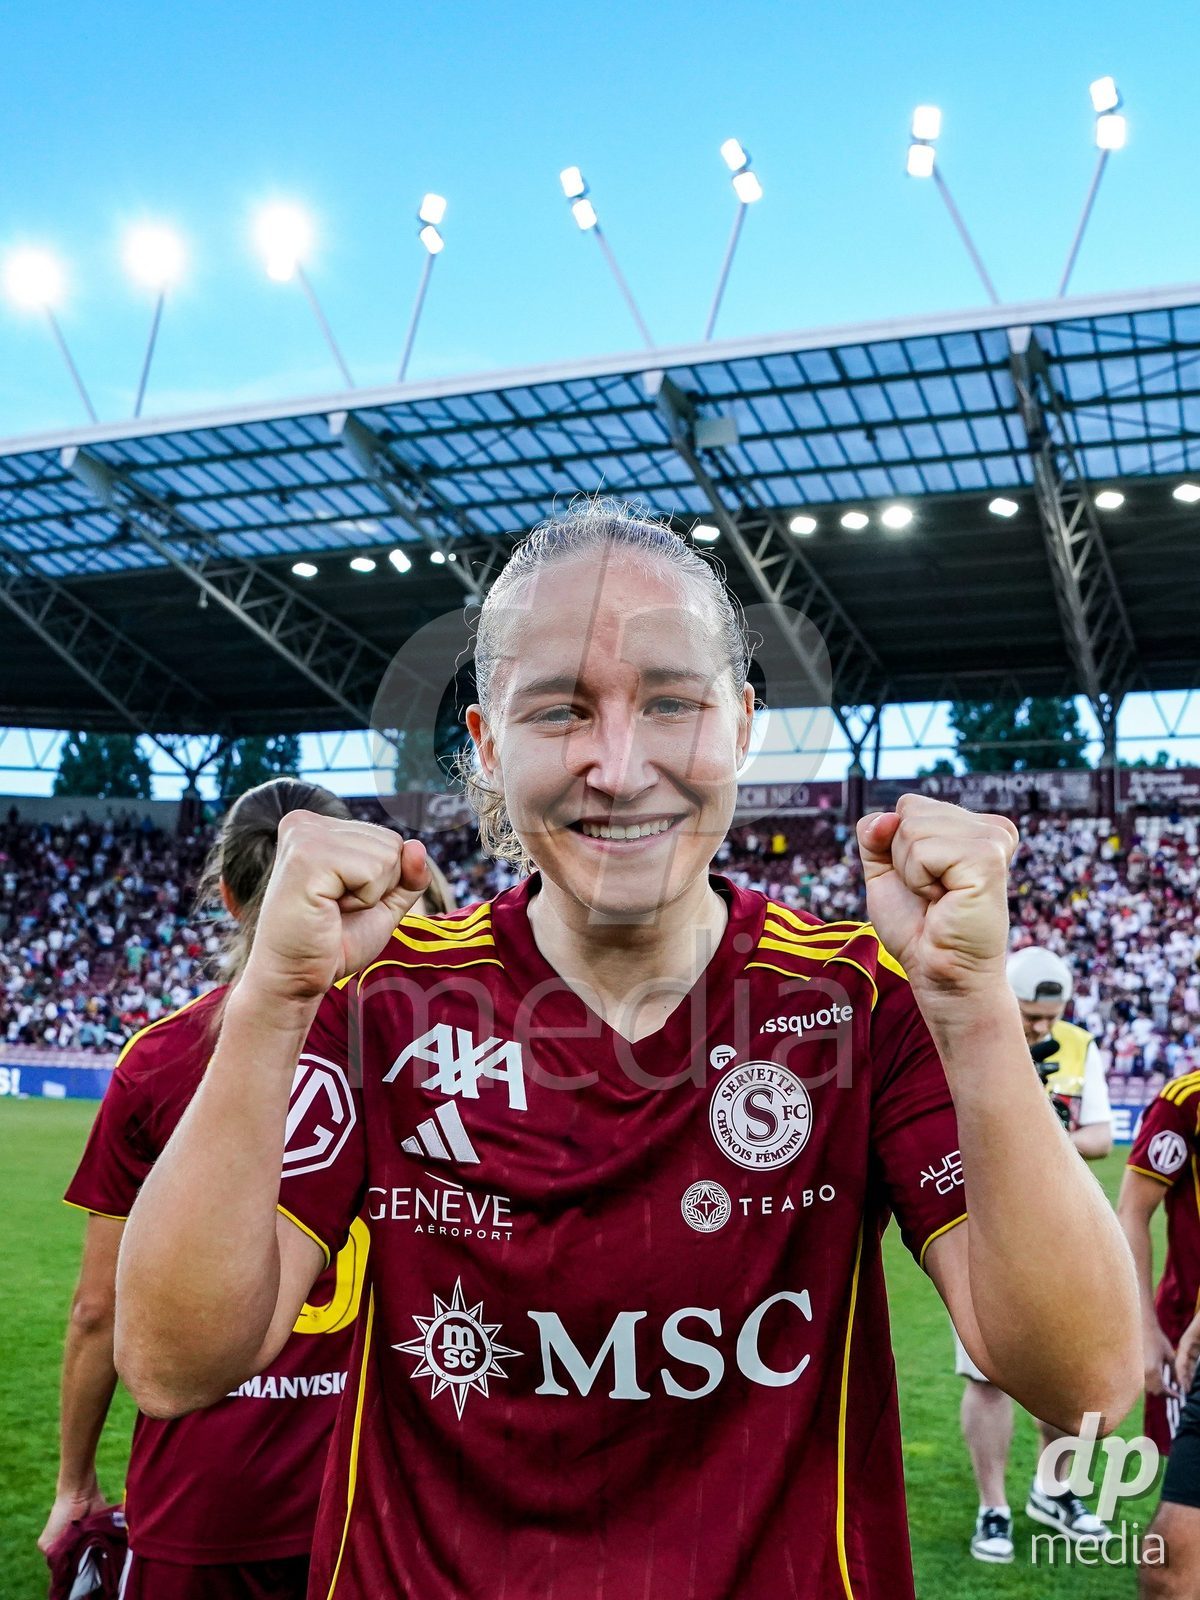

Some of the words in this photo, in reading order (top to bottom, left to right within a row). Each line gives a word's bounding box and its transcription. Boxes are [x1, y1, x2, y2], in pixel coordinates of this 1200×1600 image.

[382, 1023, 528, 1111] AXA
[721, 1068, 797, 1102] SERVETTE
[742, 1087, 779, 1142] S
[782, 1103, 808, 1121] FC
[717, 1109, 752, 1161] CHÊNOIS
[755, 1129, 802, 1163] FÉMININ
[738, 1184, 836, 1216] TEABO
[414, 1223, 513, 1241] AÉROPORT
[527, 1289, 813, 1400] MSC
